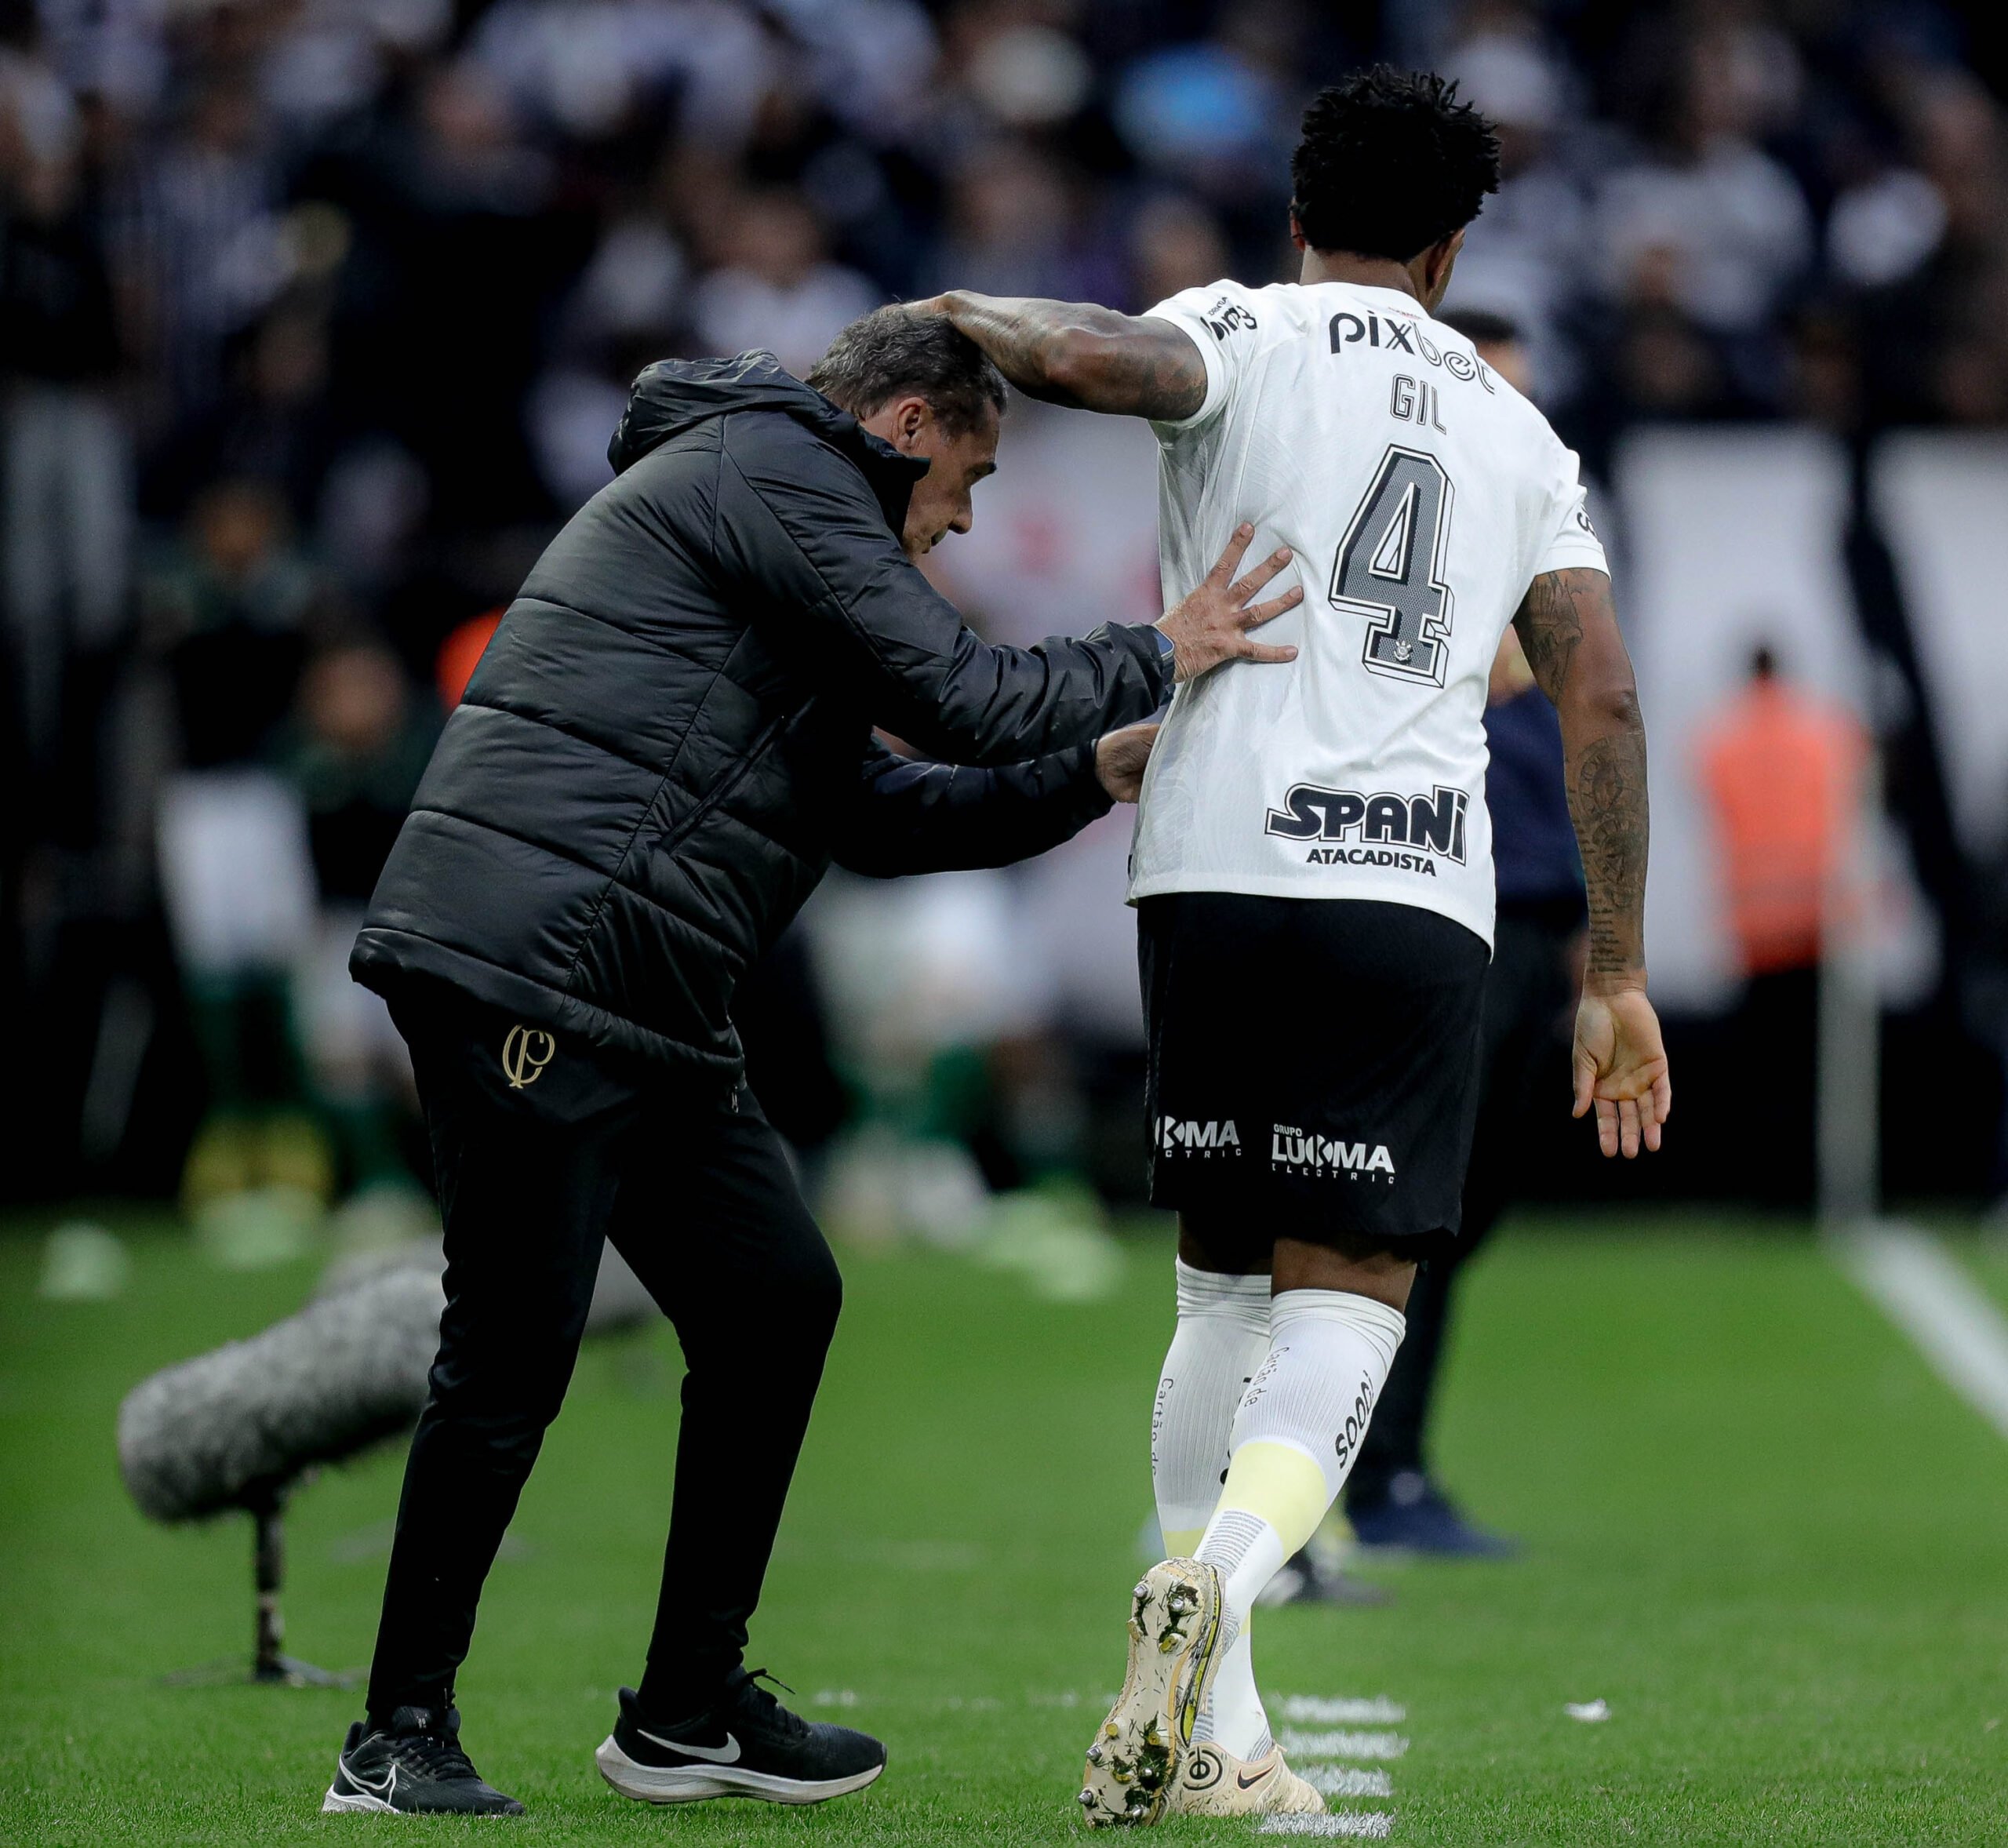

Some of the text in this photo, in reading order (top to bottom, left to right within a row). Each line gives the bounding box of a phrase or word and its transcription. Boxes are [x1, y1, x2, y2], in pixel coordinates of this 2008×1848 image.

[1329, 310, 1495, 395] pixbet
[1390, 373, 1447, 435] GIL
[1327, 443, 1455, 689] 4
[1306, 848, 1437, 877] ATACADISTA
[1273, 1123, 1303, 1137] GRUPO
[1165, 1148, 1242, 1159] CTRIC
[1271, 1162, 1395, 1184] ELECTRIC
[1151, 1377, 1174, 1442] Cartão
